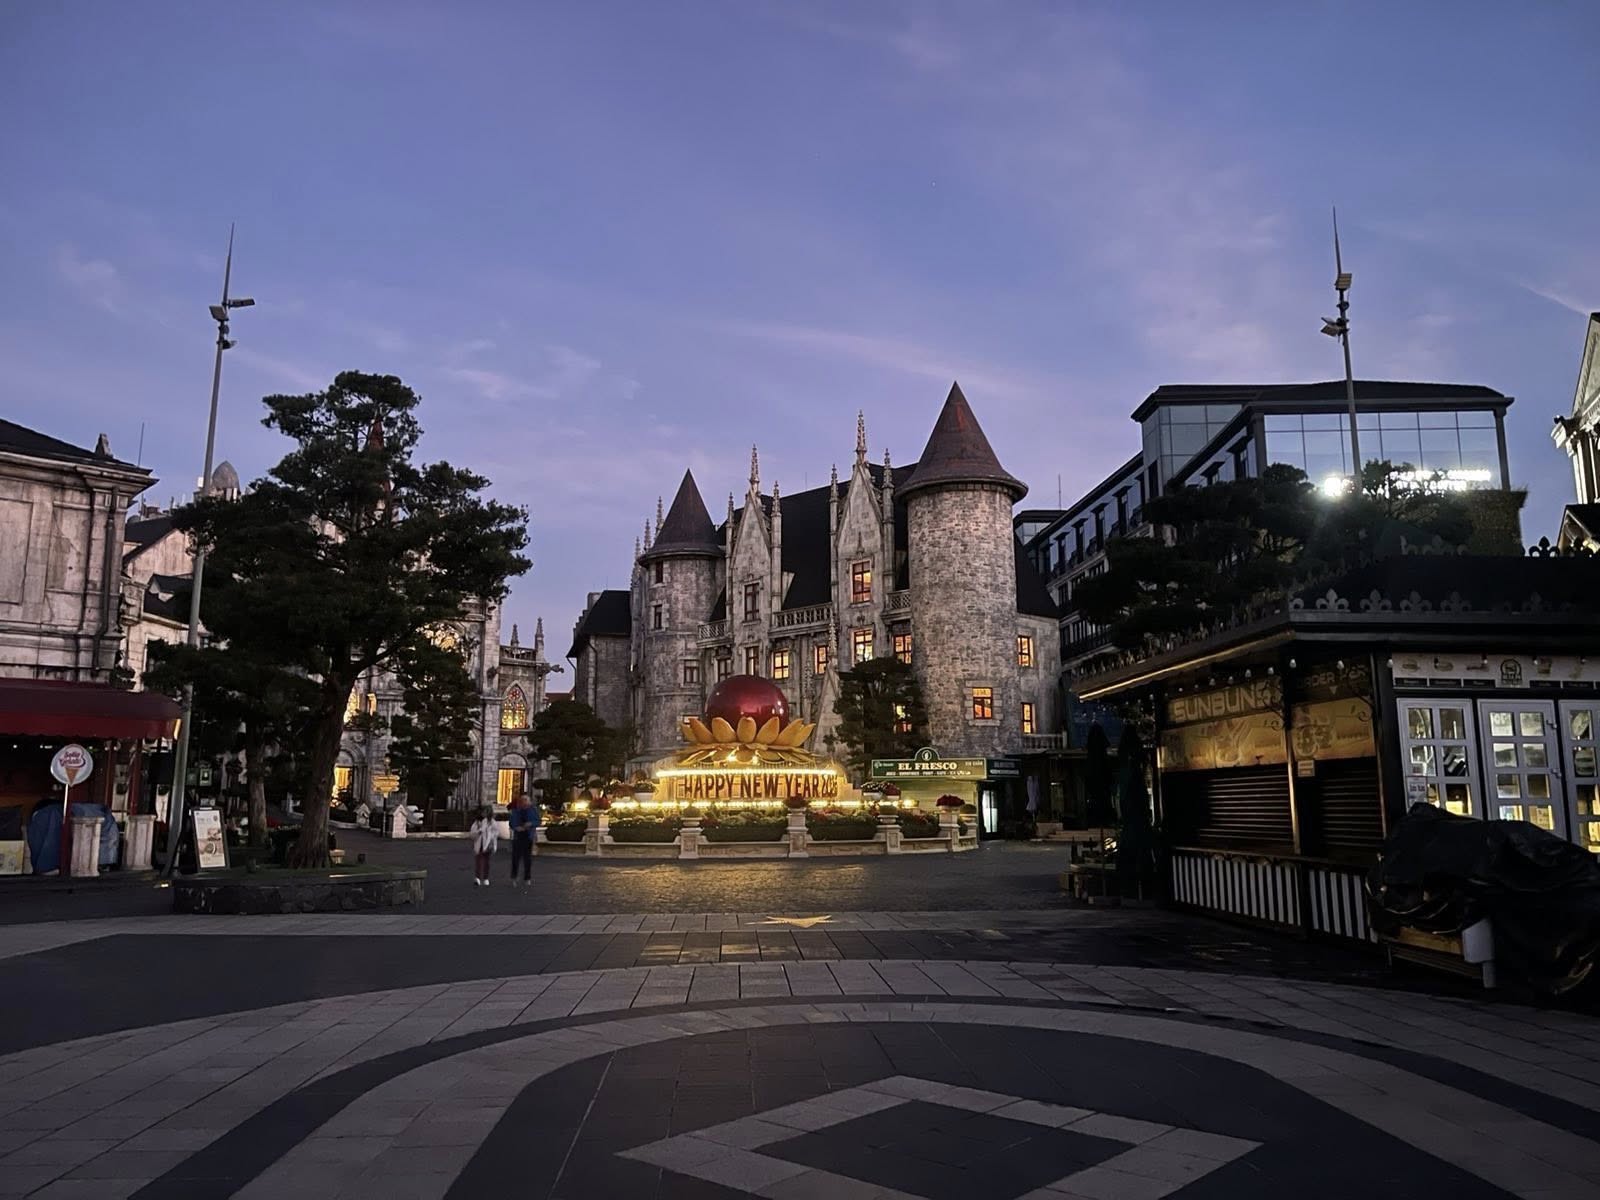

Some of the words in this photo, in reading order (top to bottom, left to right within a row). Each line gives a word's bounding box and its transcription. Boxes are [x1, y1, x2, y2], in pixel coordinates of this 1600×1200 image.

[898, 762, 912, 770] EL
[915, 762, 957, 770] FRESCO
[684, 774, 734, 798] HAPPY
[740, 774, 779, 798] NEW
[785, 774, 820, 798] YEAR
